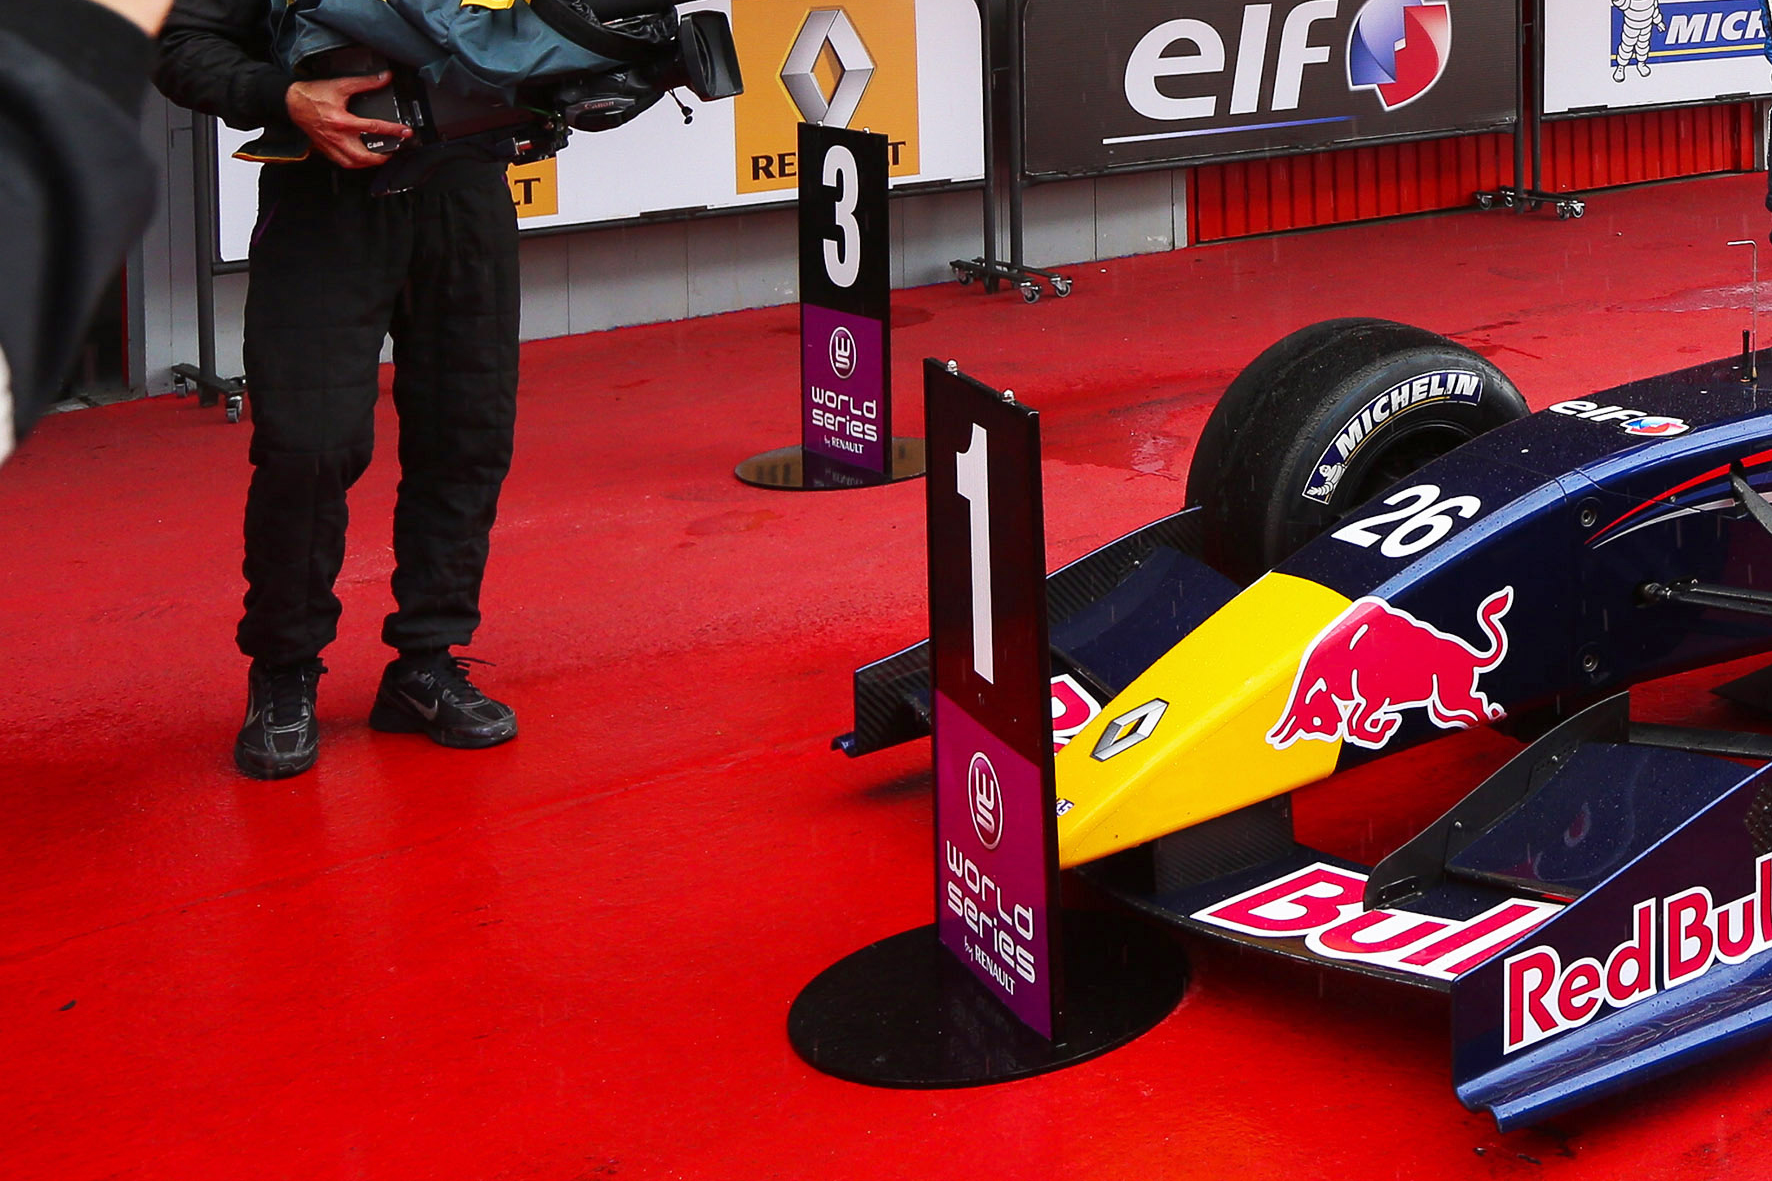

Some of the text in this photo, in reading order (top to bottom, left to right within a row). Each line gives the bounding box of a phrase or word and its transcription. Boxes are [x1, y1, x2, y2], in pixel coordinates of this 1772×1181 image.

[1664, 9, 1766, 46] MICH
[583, 99, 615, 111] Canon
[821, 145, 860, 288] 3
[811, 385, 877, 420] world
[811, 407, 878, 443] series
[1334, 373, 1479, 466] MICHELIN
[1549, 401, 1638, 425] elf
[823, 433, 865, 455] by RENAULT
[955, 422, 995, 685] 1
[1330, 482, 1482, 558] 26
[945, 839, 1034, 939] world
[946, 882, 1037, 987] series
[963, 939, 1016, 997] by RENAULT
[1506, 901, 1655, 1051] Red
